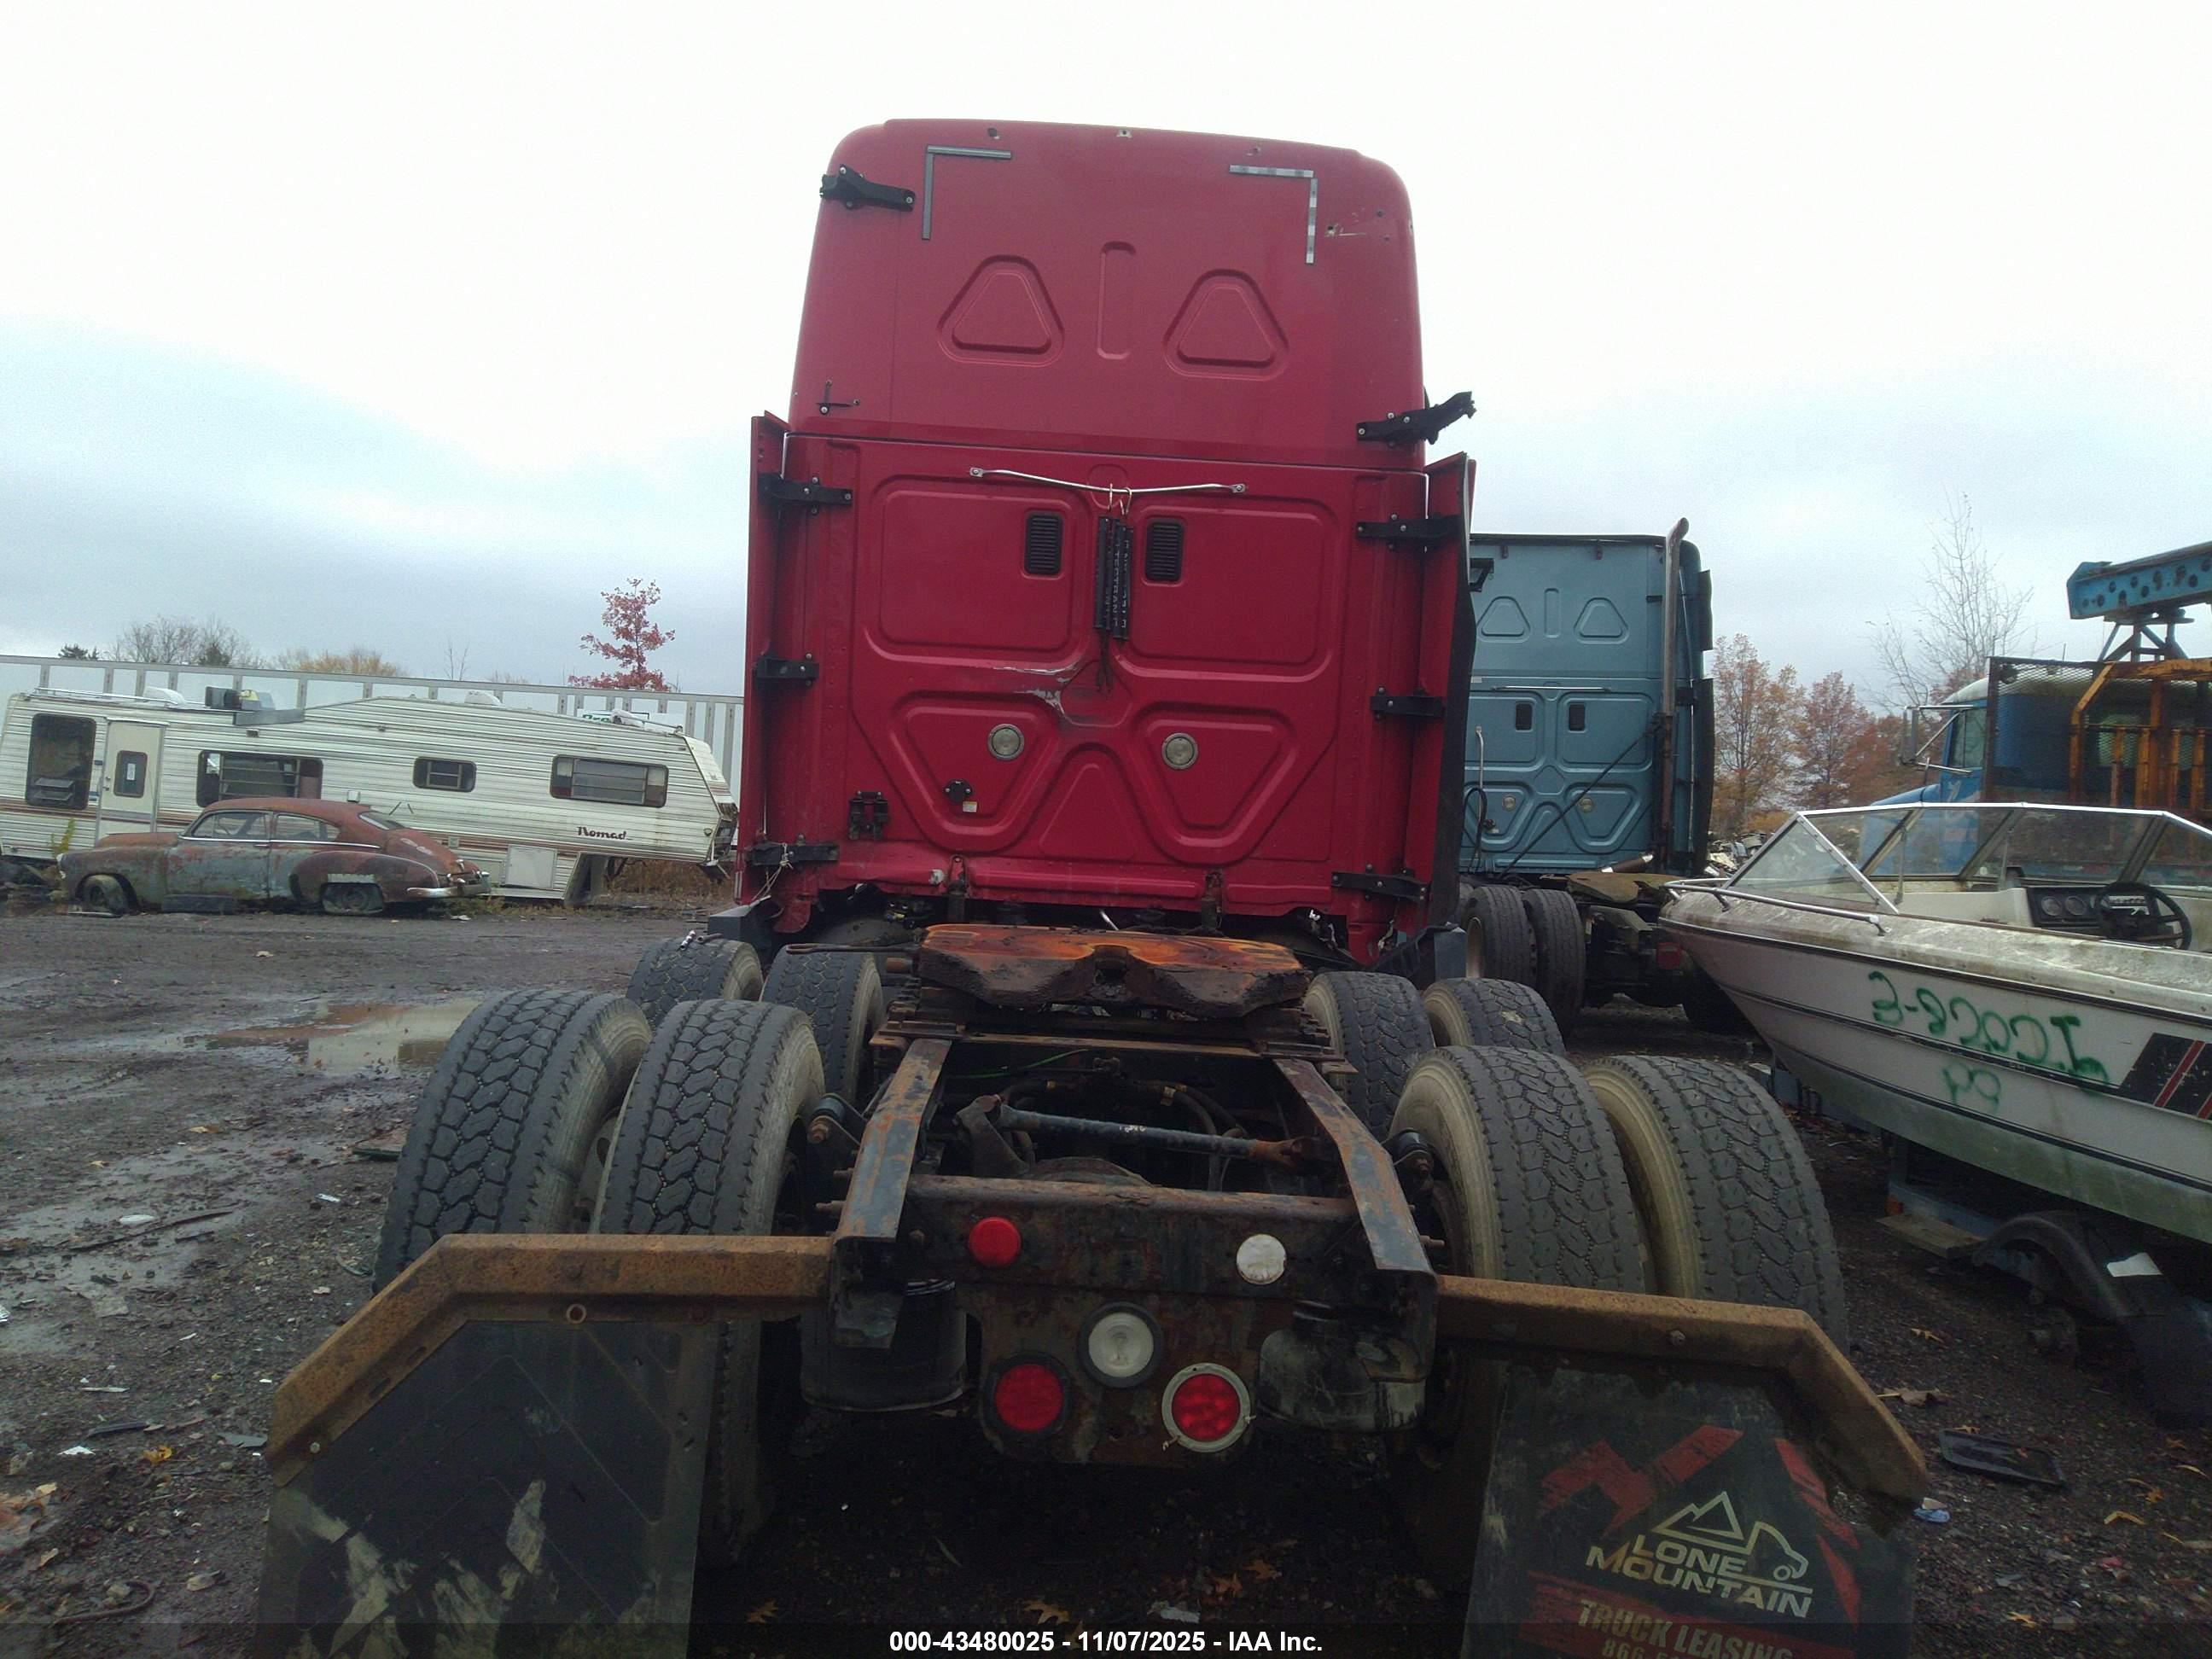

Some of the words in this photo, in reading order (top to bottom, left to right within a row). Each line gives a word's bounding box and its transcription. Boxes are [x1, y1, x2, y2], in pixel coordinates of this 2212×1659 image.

[576, 826, 627, 841] Nomad
[1633, 1534, 1747, 1577] LONE
[1586, 1541, 1812, 1618] MOUNTAIN
[1579, 1598, 1674, 1648] TRUCK
